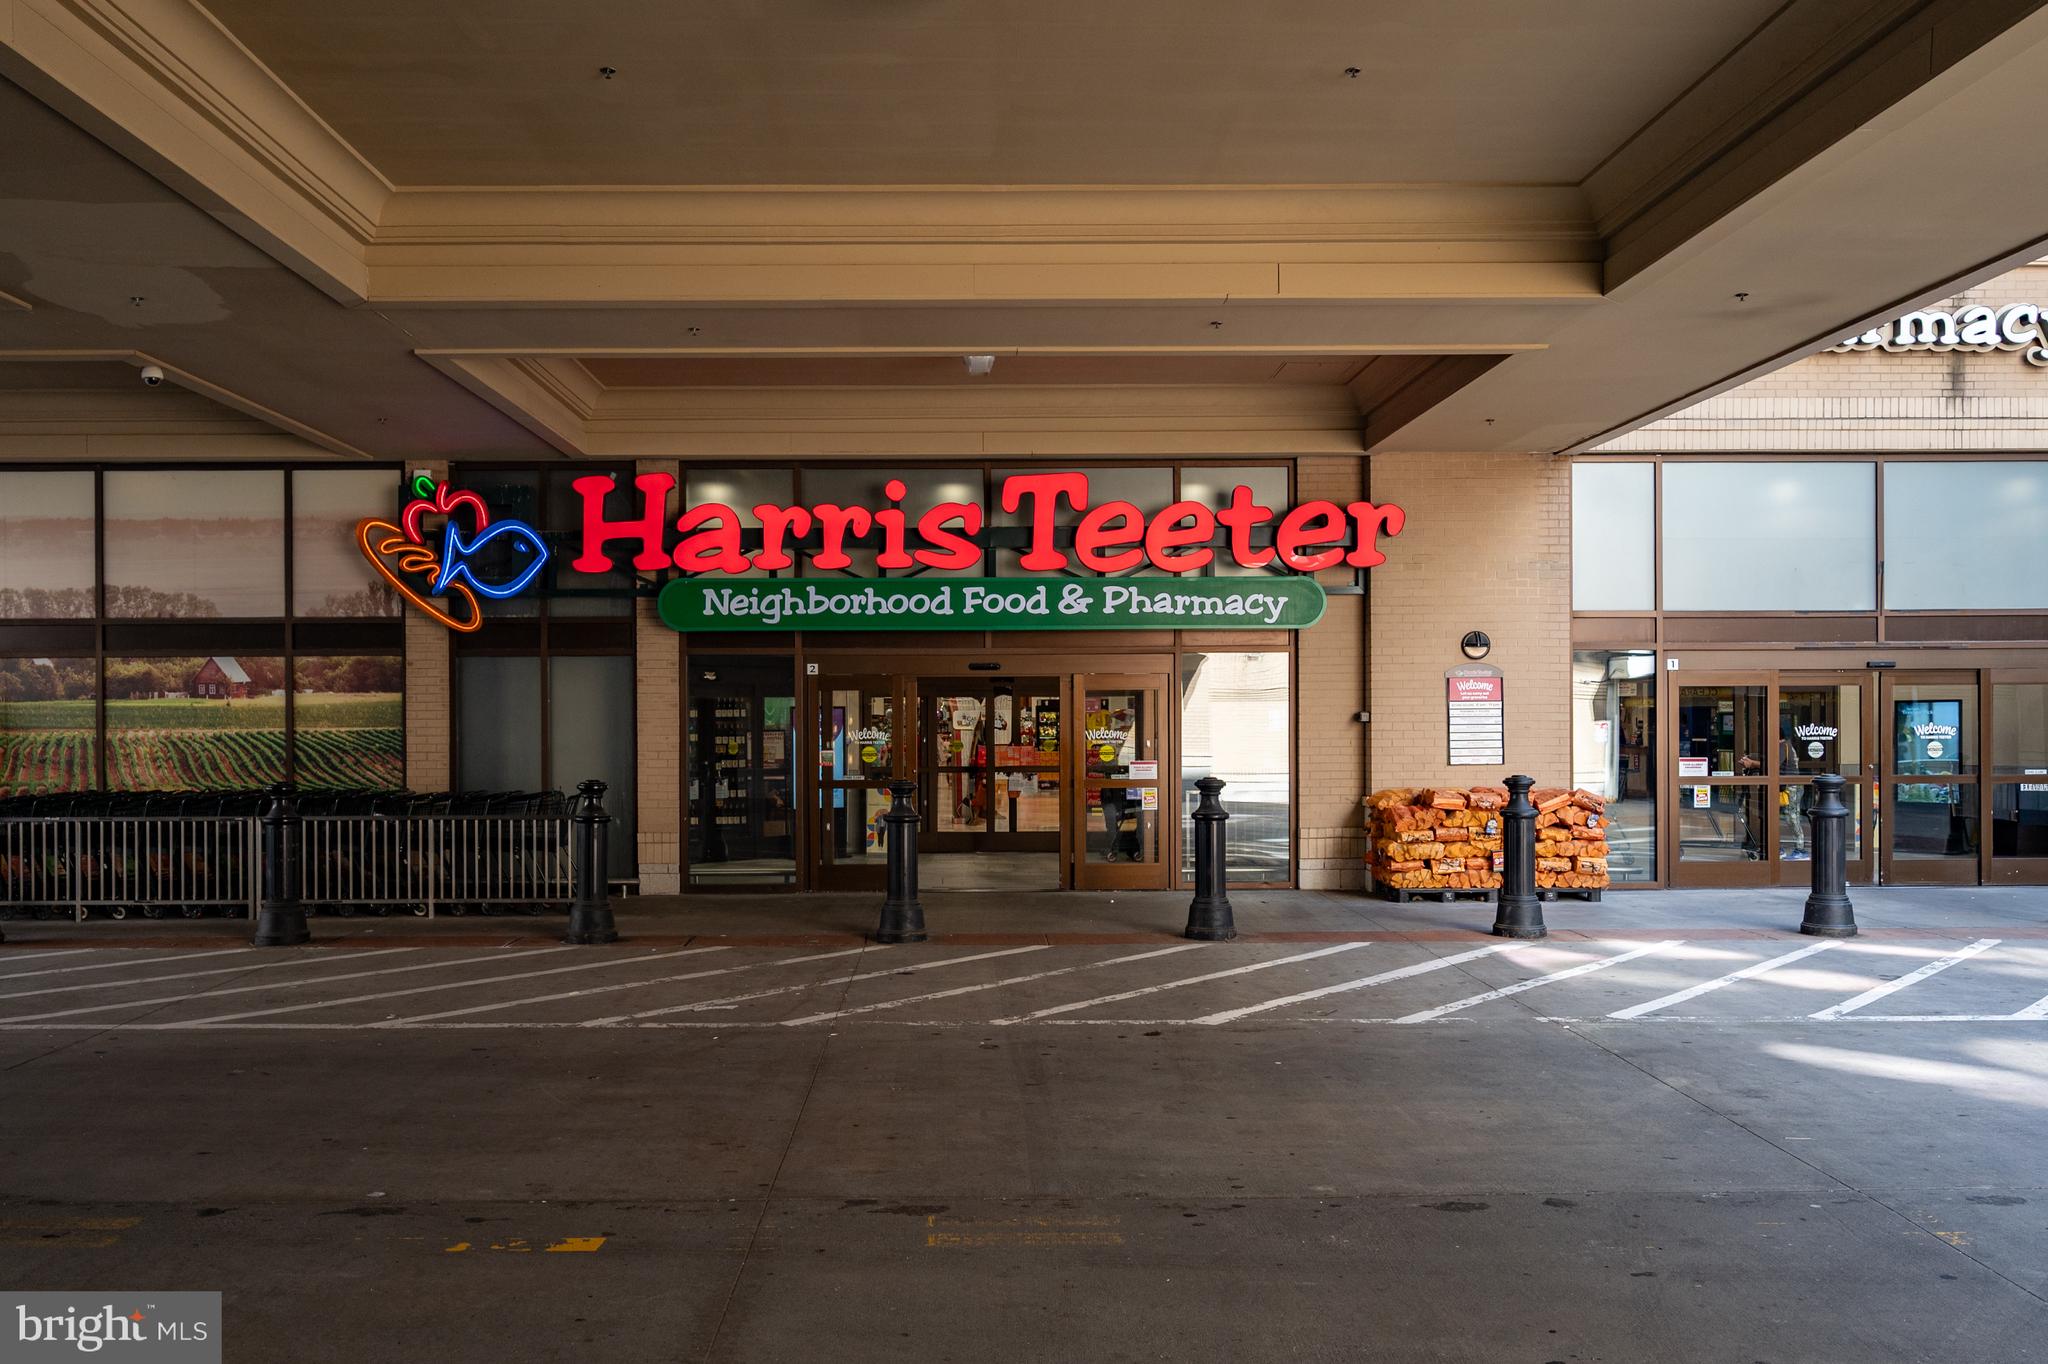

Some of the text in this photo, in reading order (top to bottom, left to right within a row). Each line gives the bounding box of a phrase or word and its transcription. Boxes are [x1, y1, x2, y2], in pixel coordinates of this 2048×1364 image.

[573, 472, 1405, 573] Harris Teeter
[702, 585, 1289, 624] Neighborhood Food & Pharmacy
[810, 665, 816, 673] 2
[1456, 679, 1494, 692] Welcome
[848, 727, 890, 741] Welcome
[1085, 727, 1128, 740] Welcome
[1794, 722, 1838, 738] Welcome
[1913, 721, 1957, 736] Welcome
